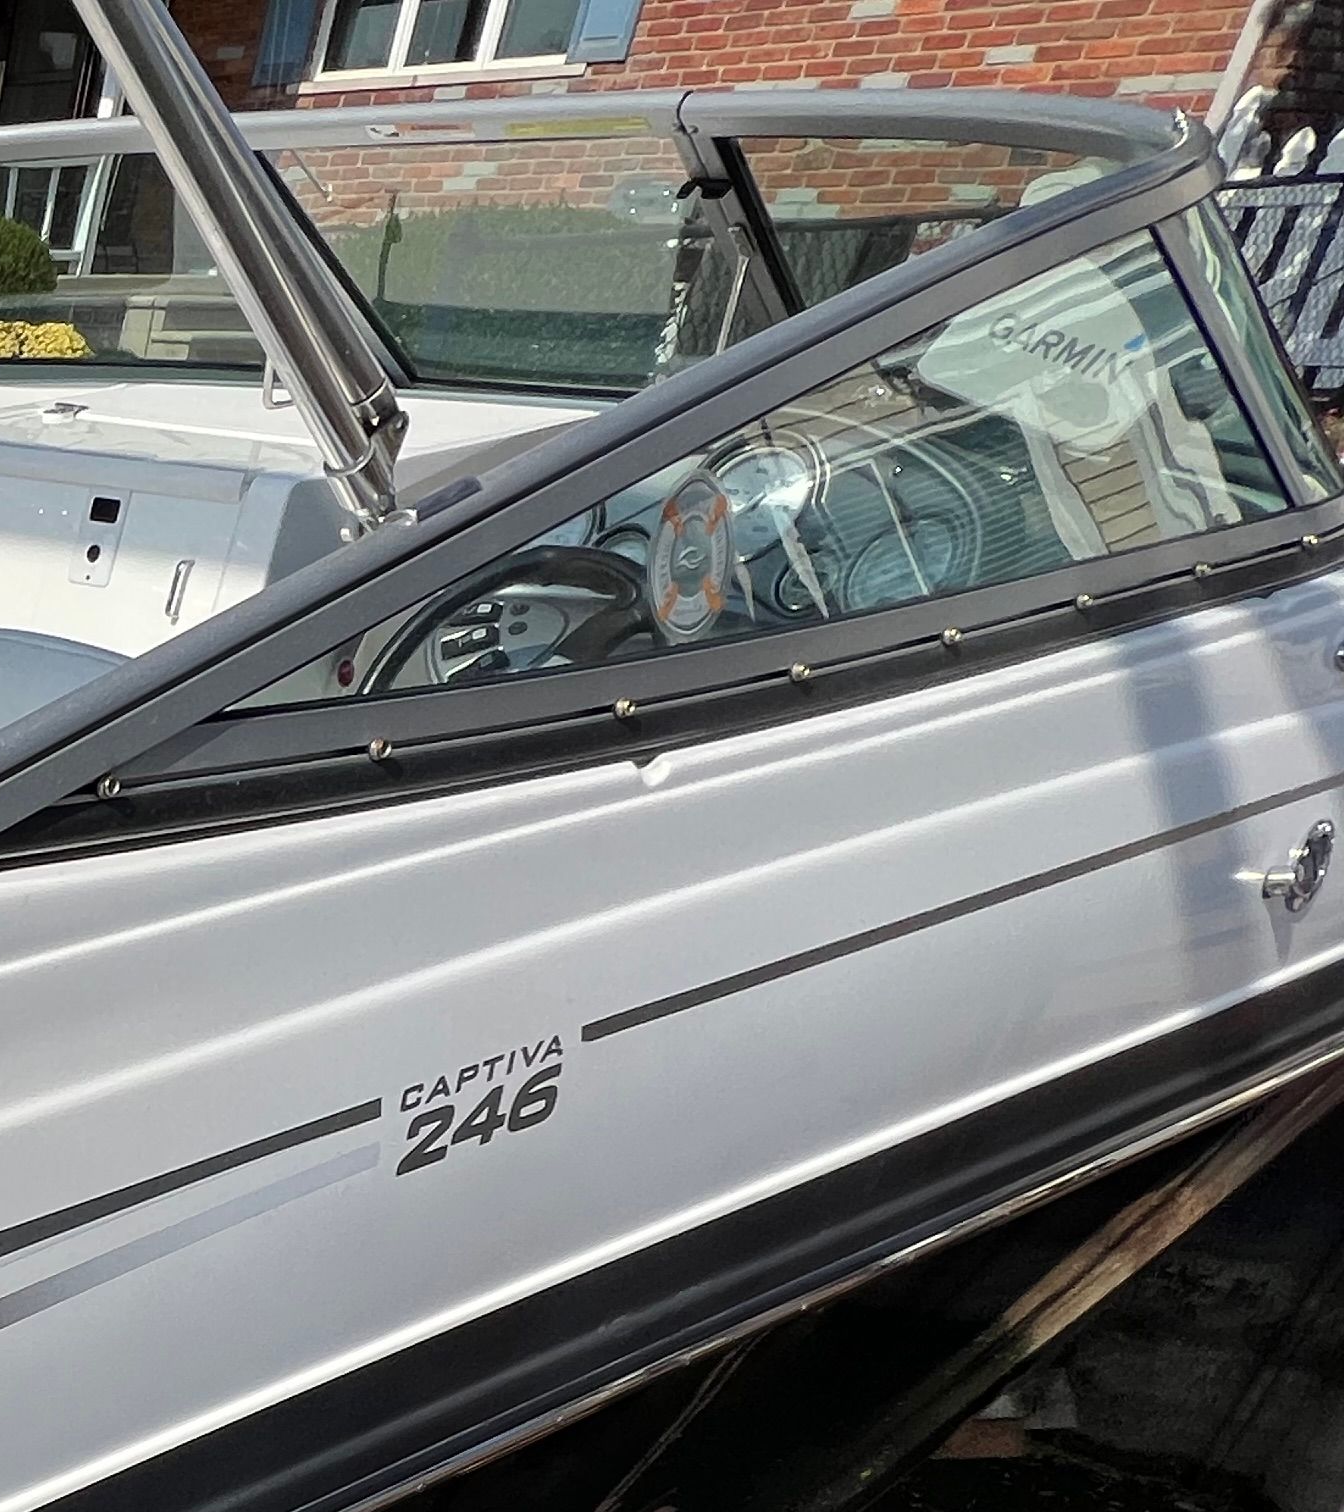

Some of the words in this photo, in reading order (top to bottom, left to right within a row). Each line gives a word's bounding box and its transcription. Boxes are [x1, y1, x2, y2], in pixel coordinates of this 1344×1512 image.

[989, 312, 1135, 386] GARMIN
[400, 1034, 563, 1112] CAPTIVA
[396, 1062, 563, 1176] 246
